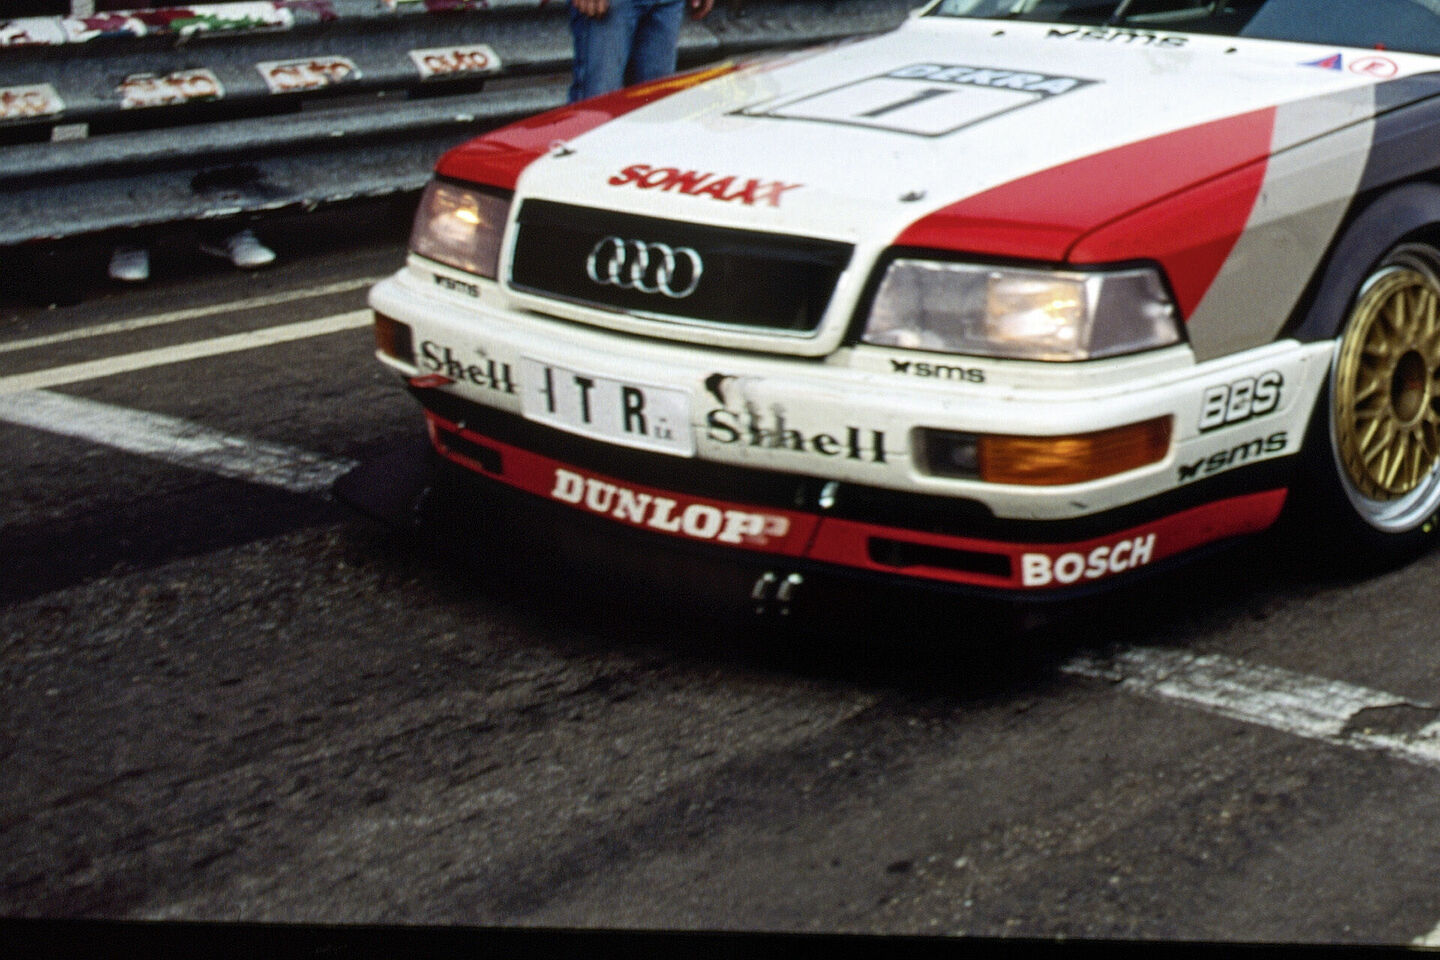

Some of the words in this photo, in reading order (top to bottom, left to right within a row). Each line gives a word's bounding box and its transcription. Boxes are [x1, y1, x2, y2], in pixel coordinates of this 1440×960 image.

[853, 88, 958, 118] 1
[888, 64, 1080, 96] DEKRA
[419, 340, 517, 394] Shell
[1198, 369, 1285, 434] BBS
[706, 403, 888, 464] Shell
[551, 468, 789, 545] DUNLOP
[1020, 534, 1156, 587] BOSCH
